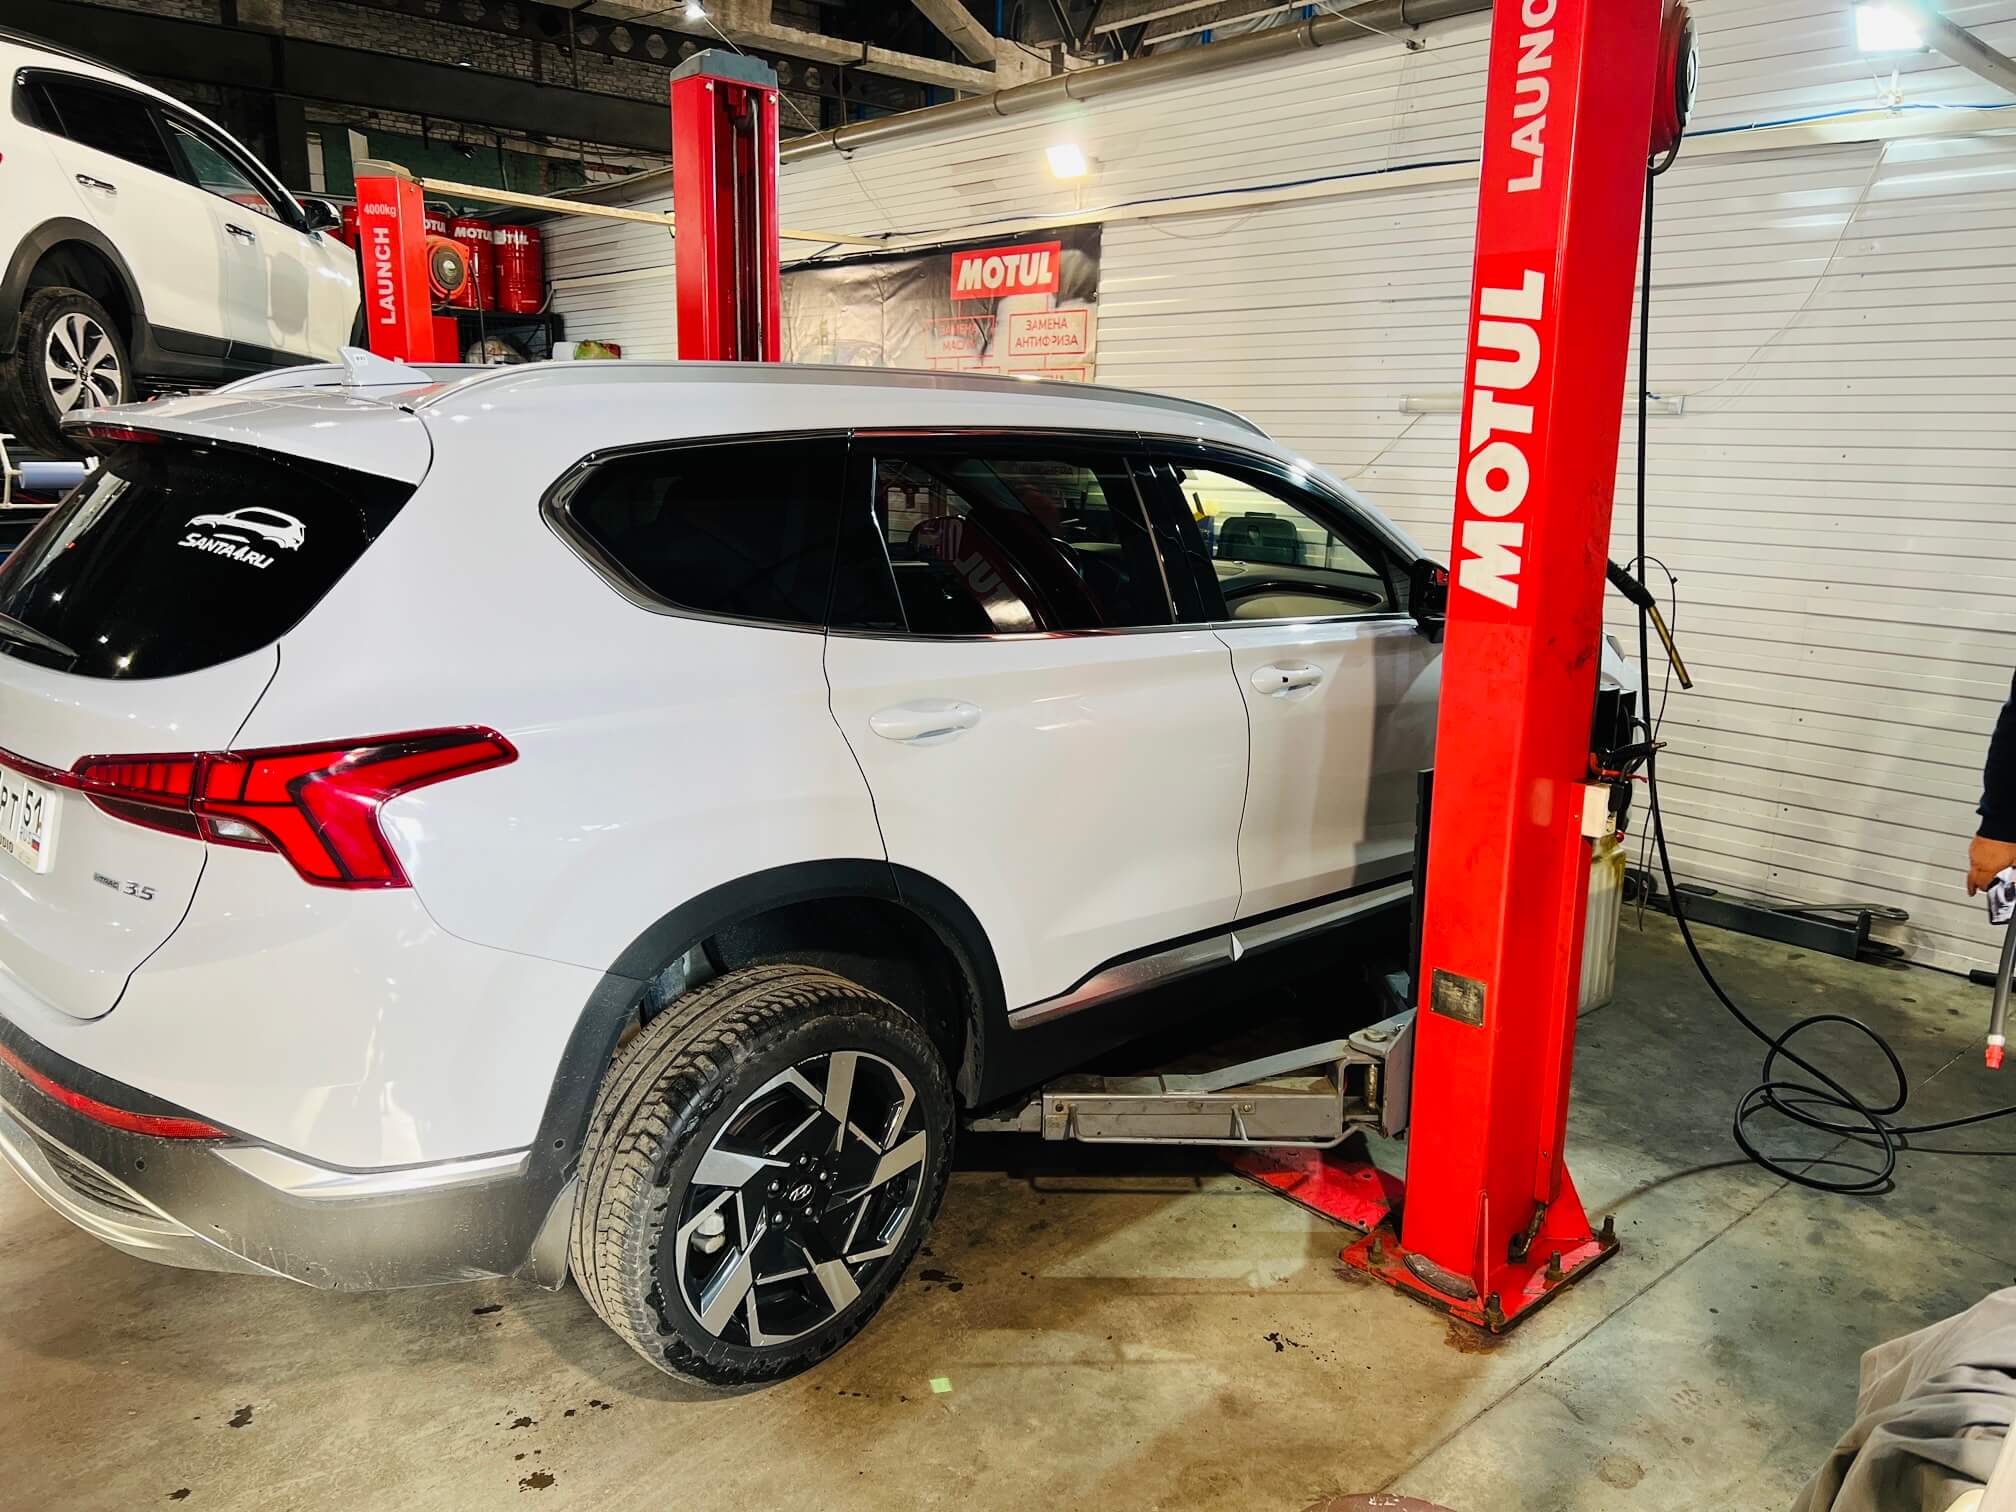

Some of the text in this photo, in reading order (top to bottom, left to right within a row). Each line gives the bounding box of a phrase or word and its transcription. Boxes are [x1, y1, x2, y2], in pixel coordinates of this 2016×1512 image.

[364, 203, 397, 217] 4000kg
[373, 227, 396, 325] LAUNCH
[957, 251, 1053, 291] MOTUL
[1015, 335, 1078, 348] АНТИФРИЗА
[1025, 319, 1068, 331] ЗАМЕНА
[1459, 269, 1545, 608] MOTUL
[24, 789, 42, 833] 51
